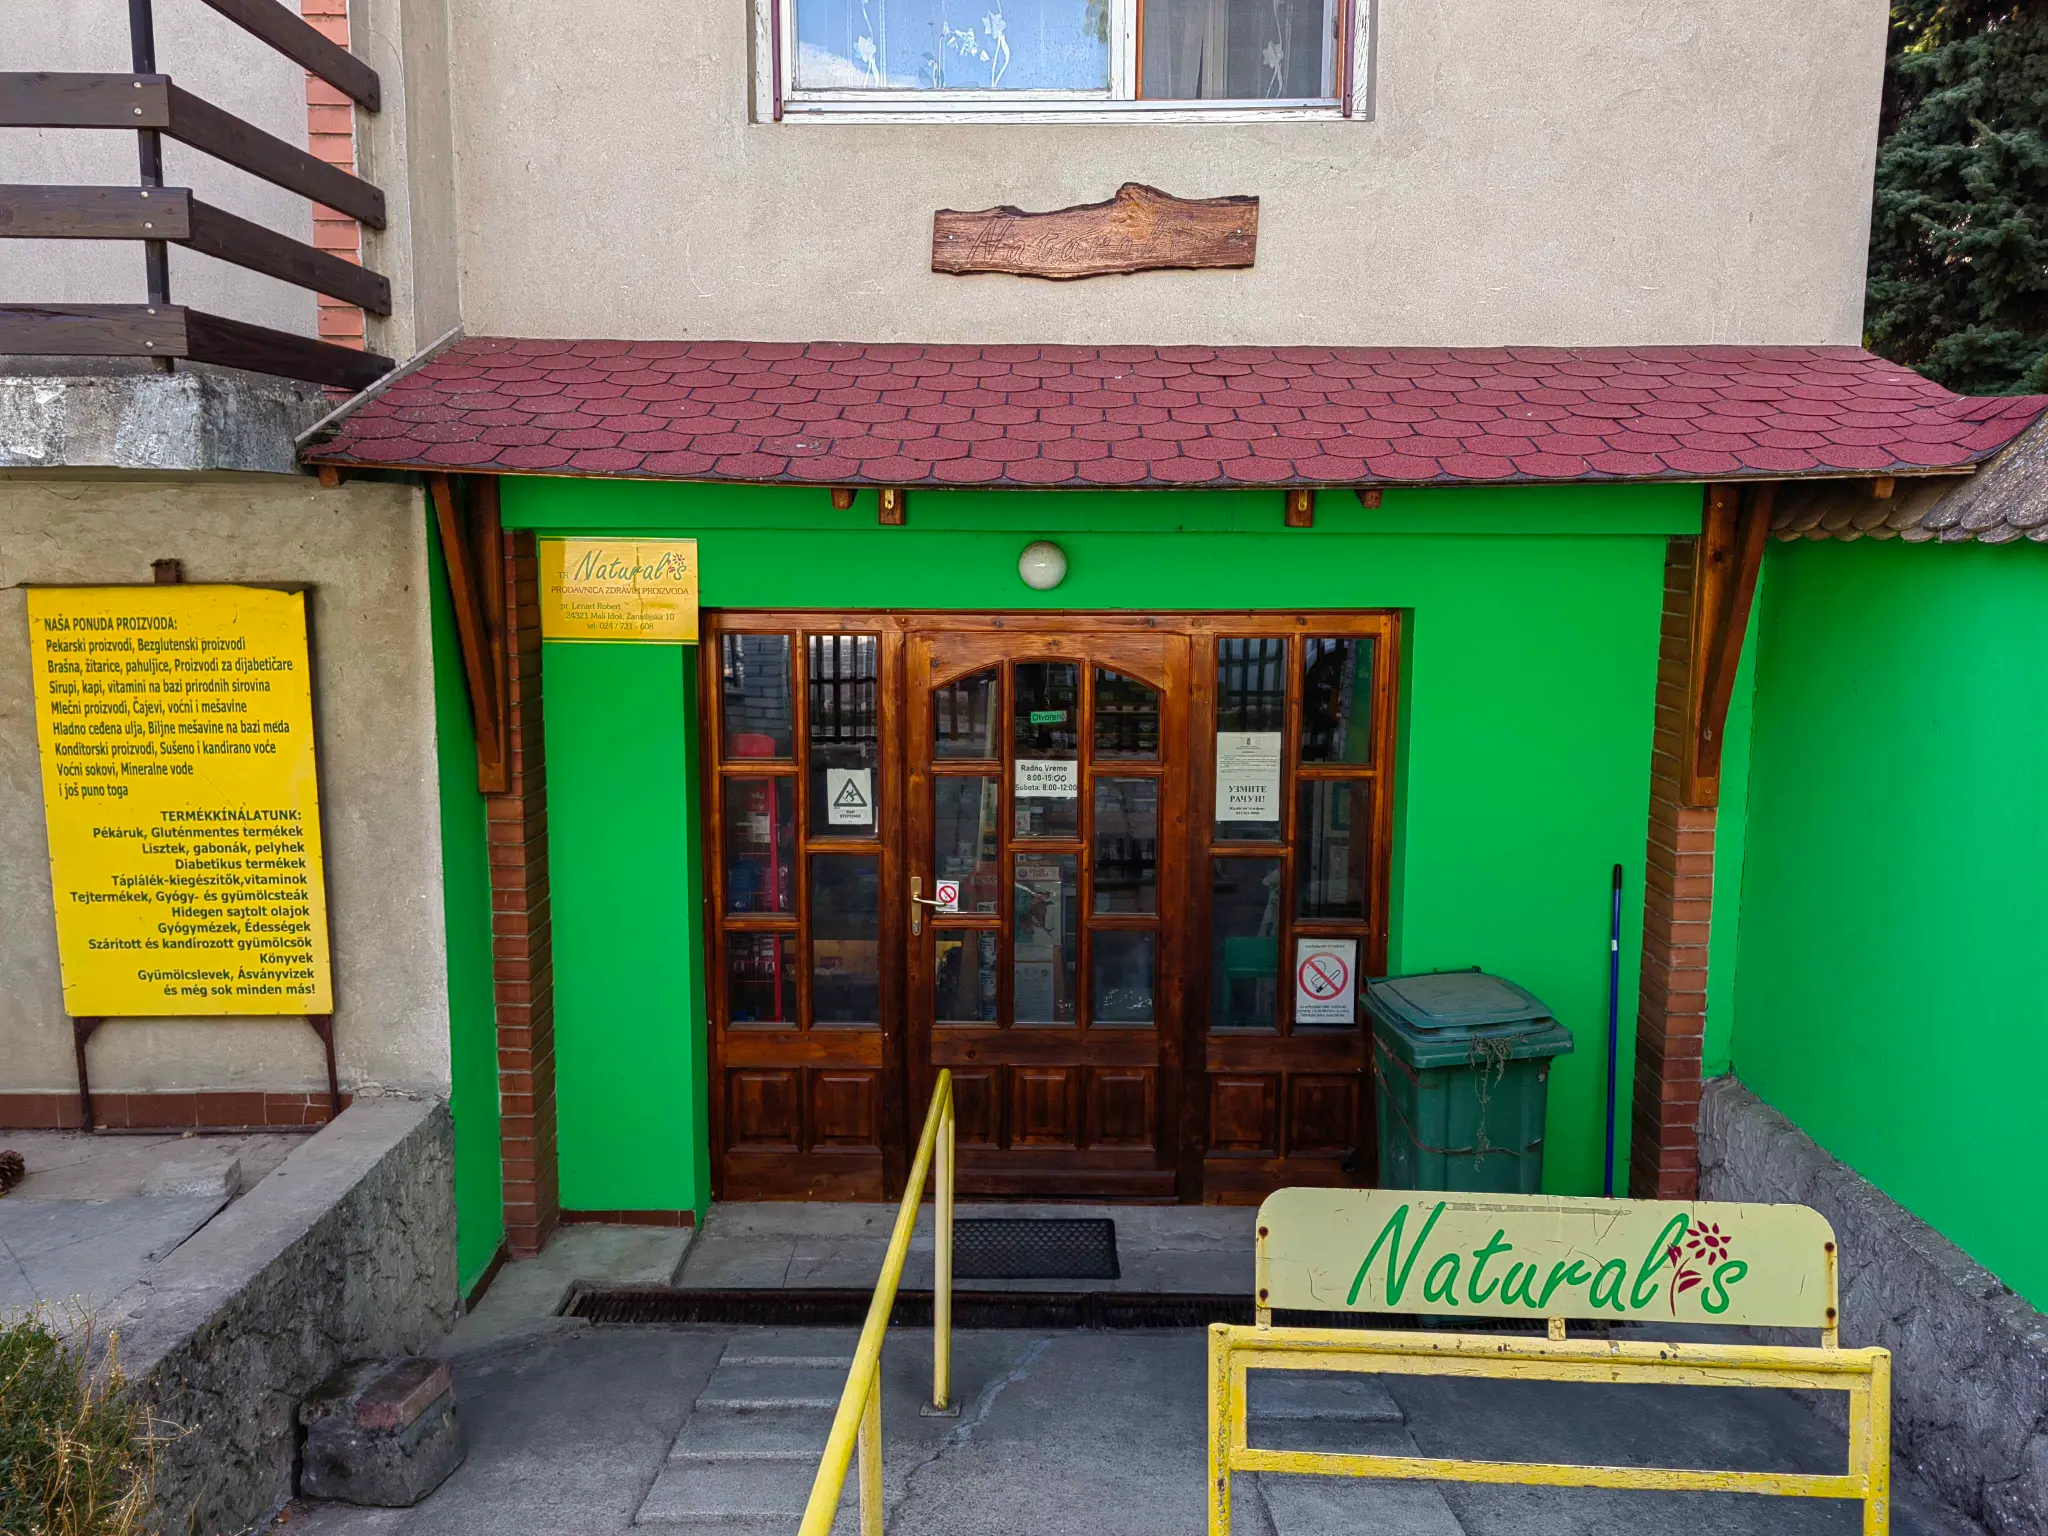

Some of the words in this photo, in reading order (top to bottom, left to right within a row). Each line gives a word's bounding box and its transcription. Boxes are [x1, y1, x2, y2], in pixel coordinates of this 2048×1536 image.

[551, 586, 603, 594] PRODAVNICA
[642, 587, 690, 595] PROIZVODA
[597, 602, 621, 610] Robert
[44, 614, 70, 631] NAŠA
[73, 617, 114, 631] PONUDA
[116, 617, 177, 630] PROIZVODA:
[565, 611, 588, 620] 24321
[590, 612, 606, 620] Mali
[665, 613, 675, 621] 10
[599, 622, 614, 630] 024
[620, 622, 633, 630] 731
[46, 639, 86, 652] Pekarski
[89, 638, 134, 655] proizvodi,
[138, 637, 198, 654] Bezglutenski
[201, 637, 245, 653] proizvodi
[48, 659, 82, 674] Brašna,
[86, 659, 122, 674] žitarice,
[126, 659, 171, 675] pahuljice,
[175, 658, 218, 672] Proizvodi
[221, 661, 232, 671] za
[235, 657, 293, 674] dijabetičare
[49, 681, 79, 696] Sirupi,
[82, 680, 105, 696] kapi,
[108, 680, 146, 693] vitamini
[149, 683, 160, 692] na
[163, 680, 182, 692] bazi
[186, 679, 229, 696] prirodnih
[232, 679, 270, 692] sirovina
[51, 700, 81, 714] Mlečni
[84, 700, 130, 717] proizvodi,
[133, 697, 165, 717] Čajevi,
[168, 700, 193, 713] voćni
[201, 699, 247, 713] mešavine
[53, 722, 86, 735] Hladno
[89, 721, 122, 735] ceđena
[125, 721, 145, 737] ulja,
[148, 721, 175, 737] Biljne
[178, 720, 223, 734] mešavine
[226, 723, 238, 733] na
[241, 720, 260, 733] bazi
[263, 720, 289, 733] meda
[55, 742, 108, 755] Konditorski
[111, 741, 157, 758] proizvodi,
[160, 741, 195, 755] Sušeno
[203, 741, 251, 754] kandirano
[253, 740, 276, 754] voće
[57, 763, 82, 776] Voćni
[85, 762, 118, 777] sokovi,
[121, 762, 168, 775] Mineralne
[170, 762, 193, 775] vode
[64, 782, 79, 800] još
[81, 786, 105, 799] puno
[107, 784, 128, 799] toga
[160, 807, 301, 821] TERMÉKKÍNÁLATUNK:
[93, 827, 147, 840] Pékáruk,
[151, 826, 239, 838] Gluténmentes
[243, 825, 303, 837] termékek
[142, 843, 189, 855] Lisztek,
[193, 841, 251, 856] gabonák,
[255, 842, 305, 855] pelyhek
[175, 858, 242, 869] Diabetikus
[245, 857, 306, 869] termékek
[70, 891, 152, 904] Tejtermékek,
[155, 890, 199, 904] Gyógy-
[204, 890, 217, 901] és
[221, 889, 308, 903] gyümölcsteák
[172, 906, 223, 919] Hidegen
[227, 906, 267, 919] sajtolt
[271, 905, 310, 919] olajok
[158, 921, 241, 935] Gyógymézek,
[245, 918, 311, 934] Édességek
[89, 938, 142, 949] Szárított
[145, 938, 159, 949] és
[162, 937, 234, 949] kandírozott
[238, 937, 312, 951] gyümölcsök
[260, 952, 313, 966] Könyvek
[138, 969, 234, 982] Gyümölcslevek,
[238, 966, 314, 981] Ásványvizek
[164, 984, 178, 995] és
[181, 984, 207, 997] még
[211, 984, 232, 995] sok
[236, 984, 282, 994] minden
[286, 983, 315, 994] más!
